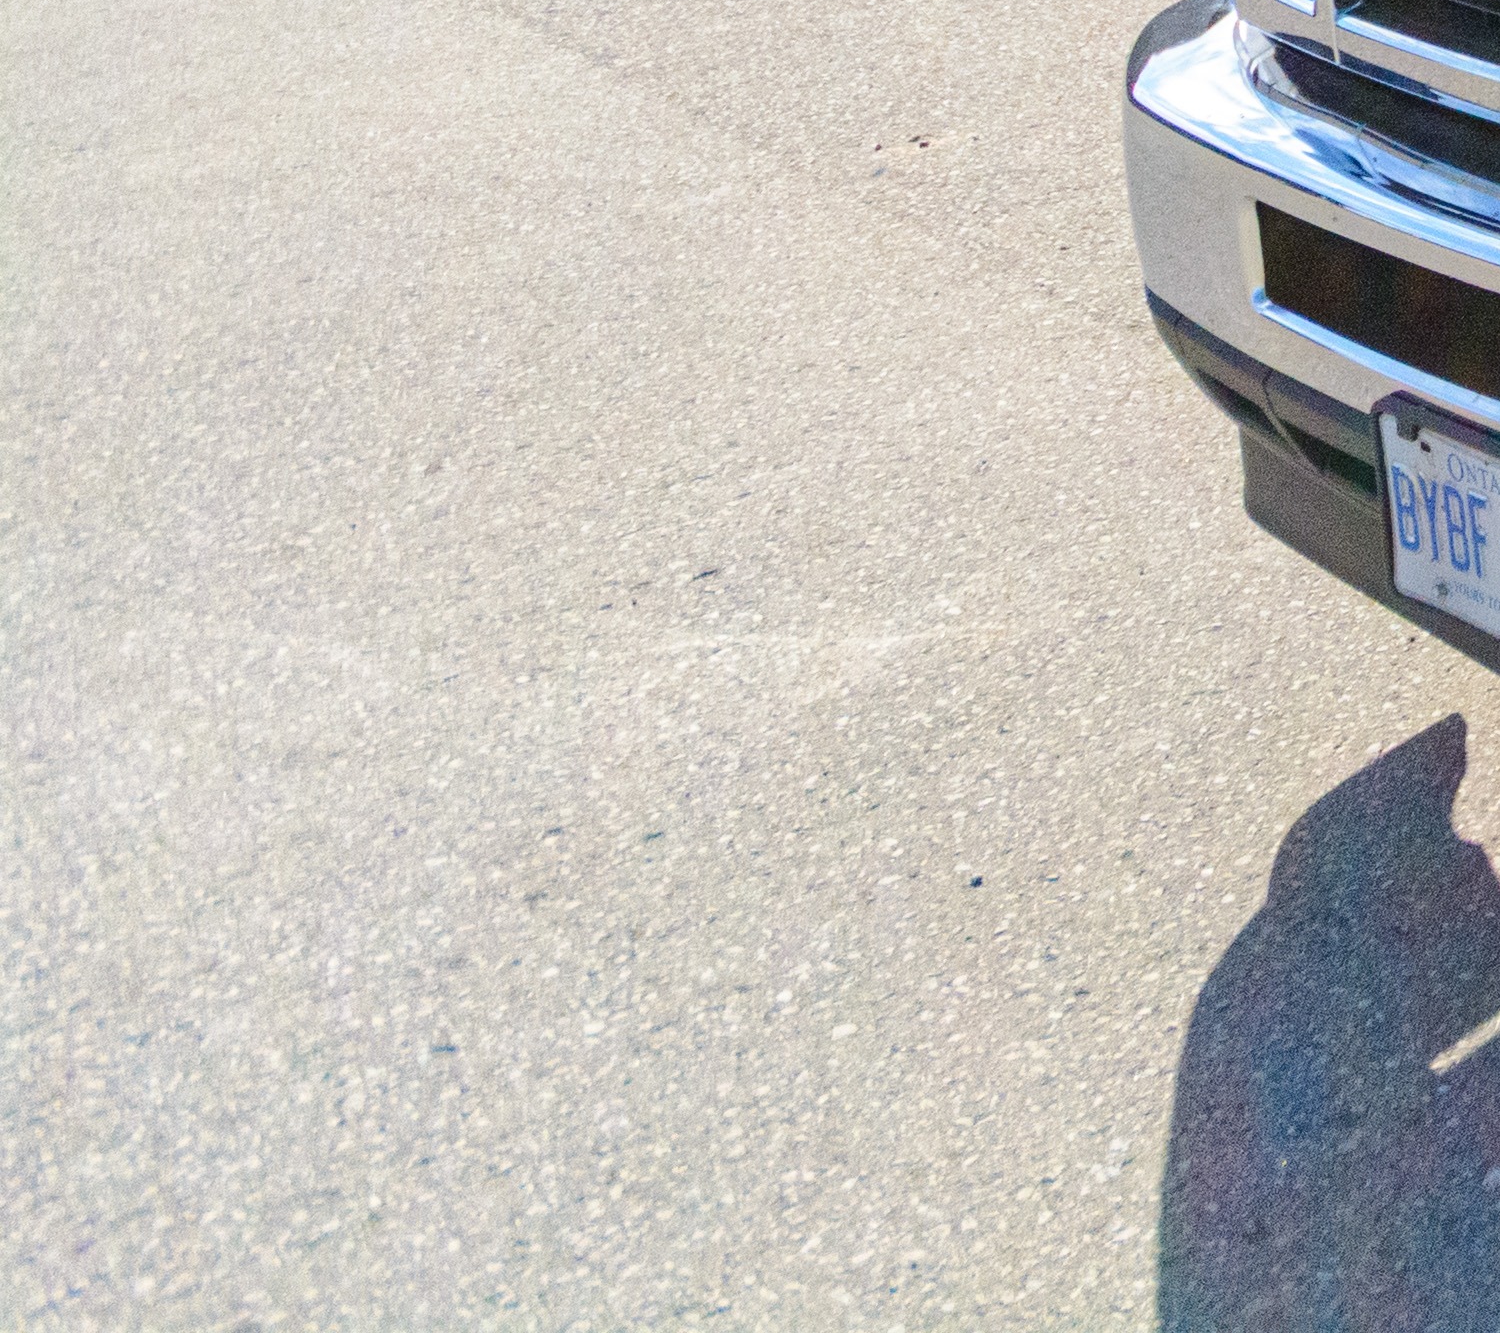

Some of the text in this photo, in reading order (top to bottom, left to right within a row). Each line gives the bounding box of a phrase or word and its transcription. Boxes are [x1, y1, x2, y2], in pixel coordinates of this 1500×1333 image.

[1391, 464, 1488, 579] BYBF
[1448, 581, 1485, 605] YOURS
[1489, 596, 1500, 611] TO
